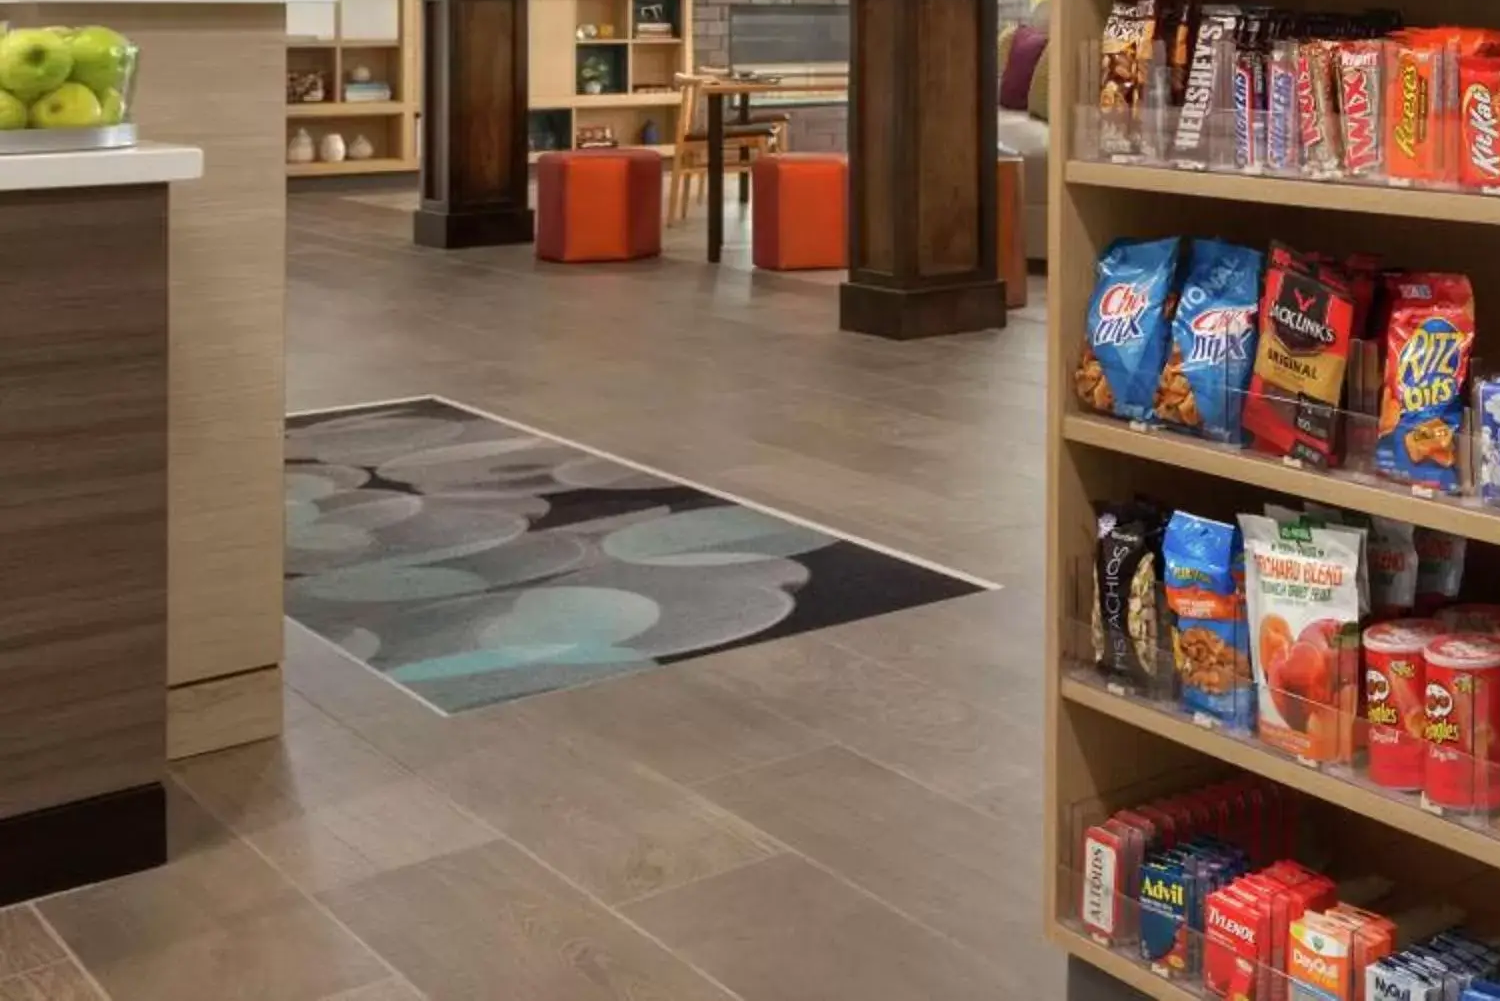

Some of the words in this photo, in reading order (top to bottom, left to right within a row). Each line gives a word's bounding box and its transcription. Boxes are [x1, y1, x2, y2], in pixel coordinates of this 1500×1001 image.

[1174, 22, 1225, 149] HERSHEY'S
[1344, 70, 1380, 170] TWIX
[1399, 329, 1465, 385] RITZ
[1141, 875, 1185, 906] Advil
[1208, 905, 1258, 945] TYLENOL
